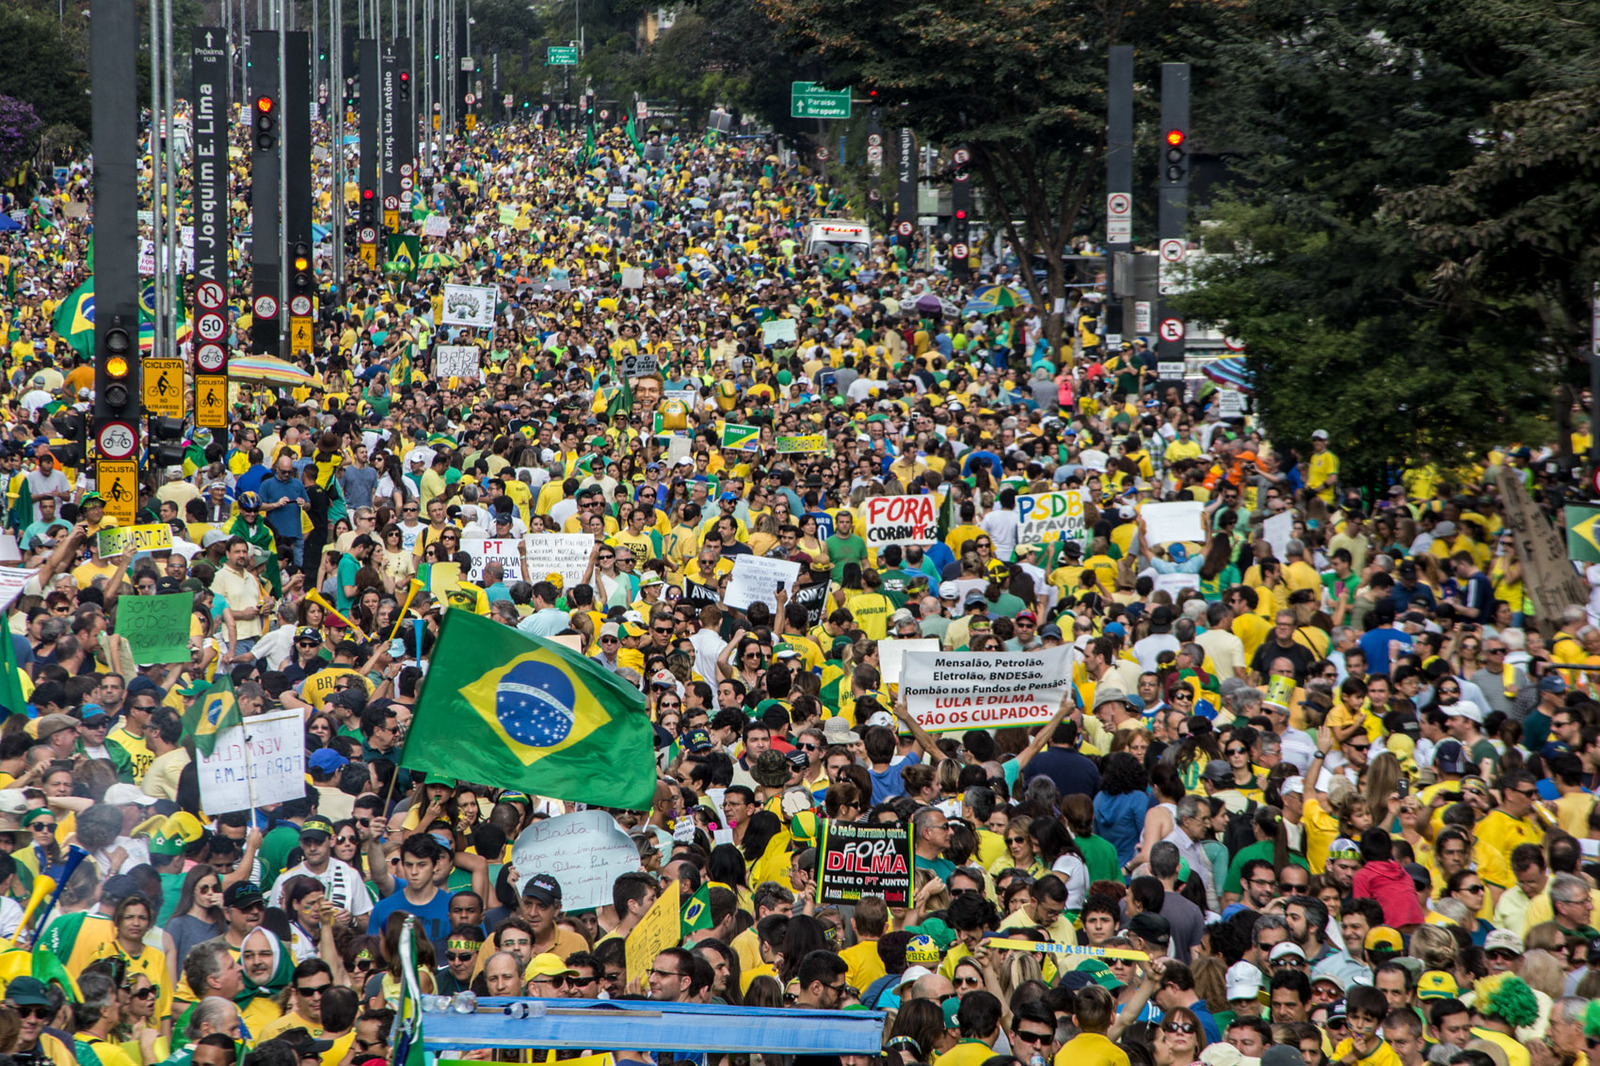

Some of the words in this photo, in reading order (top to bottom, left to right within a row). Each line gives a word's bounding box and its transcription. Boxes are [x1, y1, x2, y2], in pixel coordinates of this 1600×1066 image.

[194, 48, 224, 56] Próxima
[198, 83, 214, 133] Lima
[198, 139, 214, 156] E.
[198, 162, 217, 248] Joaquim
[199, 254, 216, 280] Al.
[202, 319, 220, 332] 50
[1166, 323, 1176, 336] E
[440, 352, 479, 364] BRASIL
[144, 361, 182, 370] CICLISTA
[868, 497, 934, 524] FORA
[1017, 491, 1083, 524] PSDB
[868, 523, 938, 542] CORRUPTOS
[1024, 522, 1035, 534] A
[1022, 534, 1036, 544] DO
[1043, 528, 1084, 542] BRASIL
[483, 541, 502, 554] PT
[668, 534, 678, 555] 7
[485, 556, 519, 566] DEVOLVA
[471, 568, 477, 578] O
[127, 601, 168, 614] SOMOS
[127, 614, 178, 630] TODOS
[935, 659, 992, 668] Mensalão,
[995, 658, 1044, 667] Petrolão,
[933, 672, 986, 681] Eletrolão,
[990, 672, 1043, 680] BNDESão,
[905, 687, 949, 695] Rombão
[972, 684, 1010, 693] Fundos
[1014, 684, 1025, 692] de
[1029, 679, 1066, 691] Pensão:
[936, 697, 971, 708] LULA
[976, 696, 984, 706] E
[986, 694, 1034, 705] DILMA
[916, 710, 945, 726] SÃO
[950, 711, 968, 724] OS
[971, 705, 1053, 722] CULPADOS.
[136, 754, 153, 766] FOR
[535, 821, 590, 842] Basta
[830, 826, 837, 835] O
[838, 825, 856, 837] PAÍS
[857, 828, 886, 838] INTEIRO
[844, 839, 896, 858] FORA
[590, 856, 609, 868] Lula
[827, 850, 908, 874] DILMA
[832, 875, 854, 884] LEVE
[865, 876, 878, 885] PT
[825, 886, 829, 898] A
[830, 889, 842, 899] nossa
[1046, 943, 1096, 956] BRASIL
